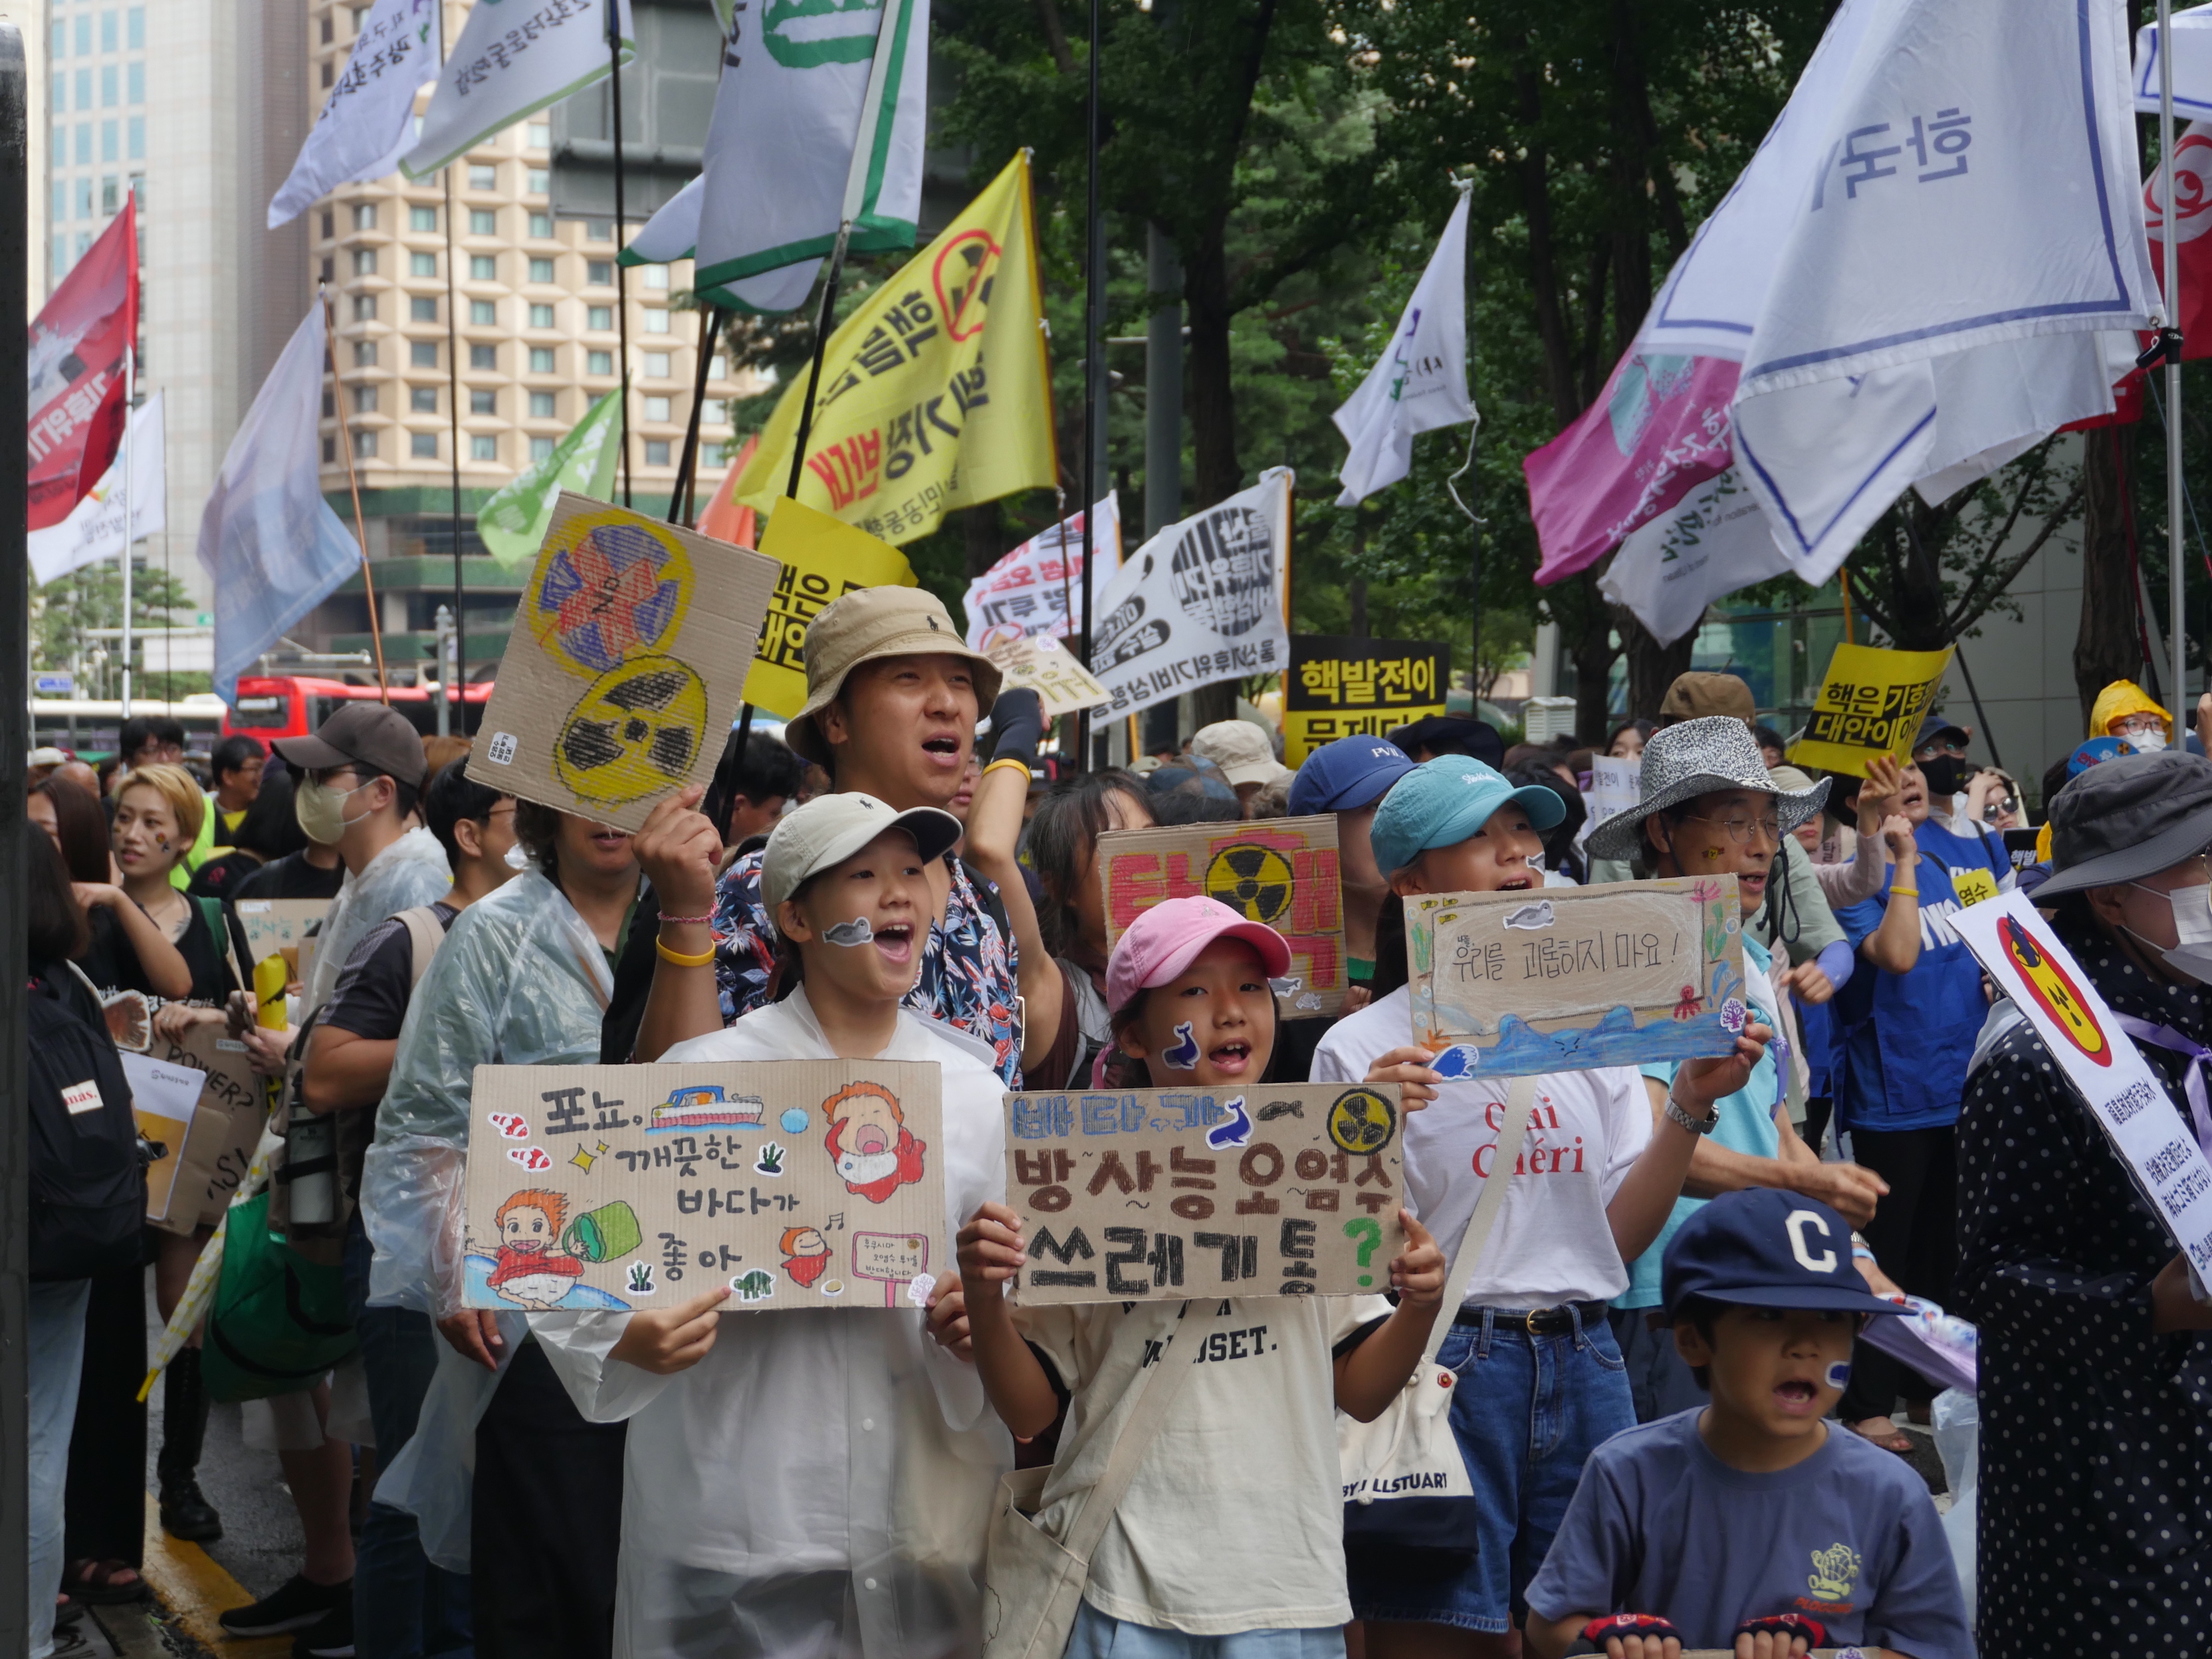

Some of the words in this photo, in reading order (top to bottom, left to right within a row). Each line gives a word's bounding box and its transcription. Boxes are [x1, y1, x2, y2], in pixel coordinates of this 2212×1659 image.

[1300, 655, 1435, 704] 핵발전이
[1828, 683, 1879, 715] 핵은
[1815, 715, 1897, 748] 대안이
[1453, 942, 1505, 982] 우리를
[1522, 931, 1605, 979] 괴롭히지
[615, 1134, 742, 1176] 깨끗한
[677, 1186, 800, 1217] 바다가
[657, 1232, 742, 1282] 좋아
[864, 1238, 895, 1250] 후쿠시마
[1785, 1209, 1838, 1273] C
